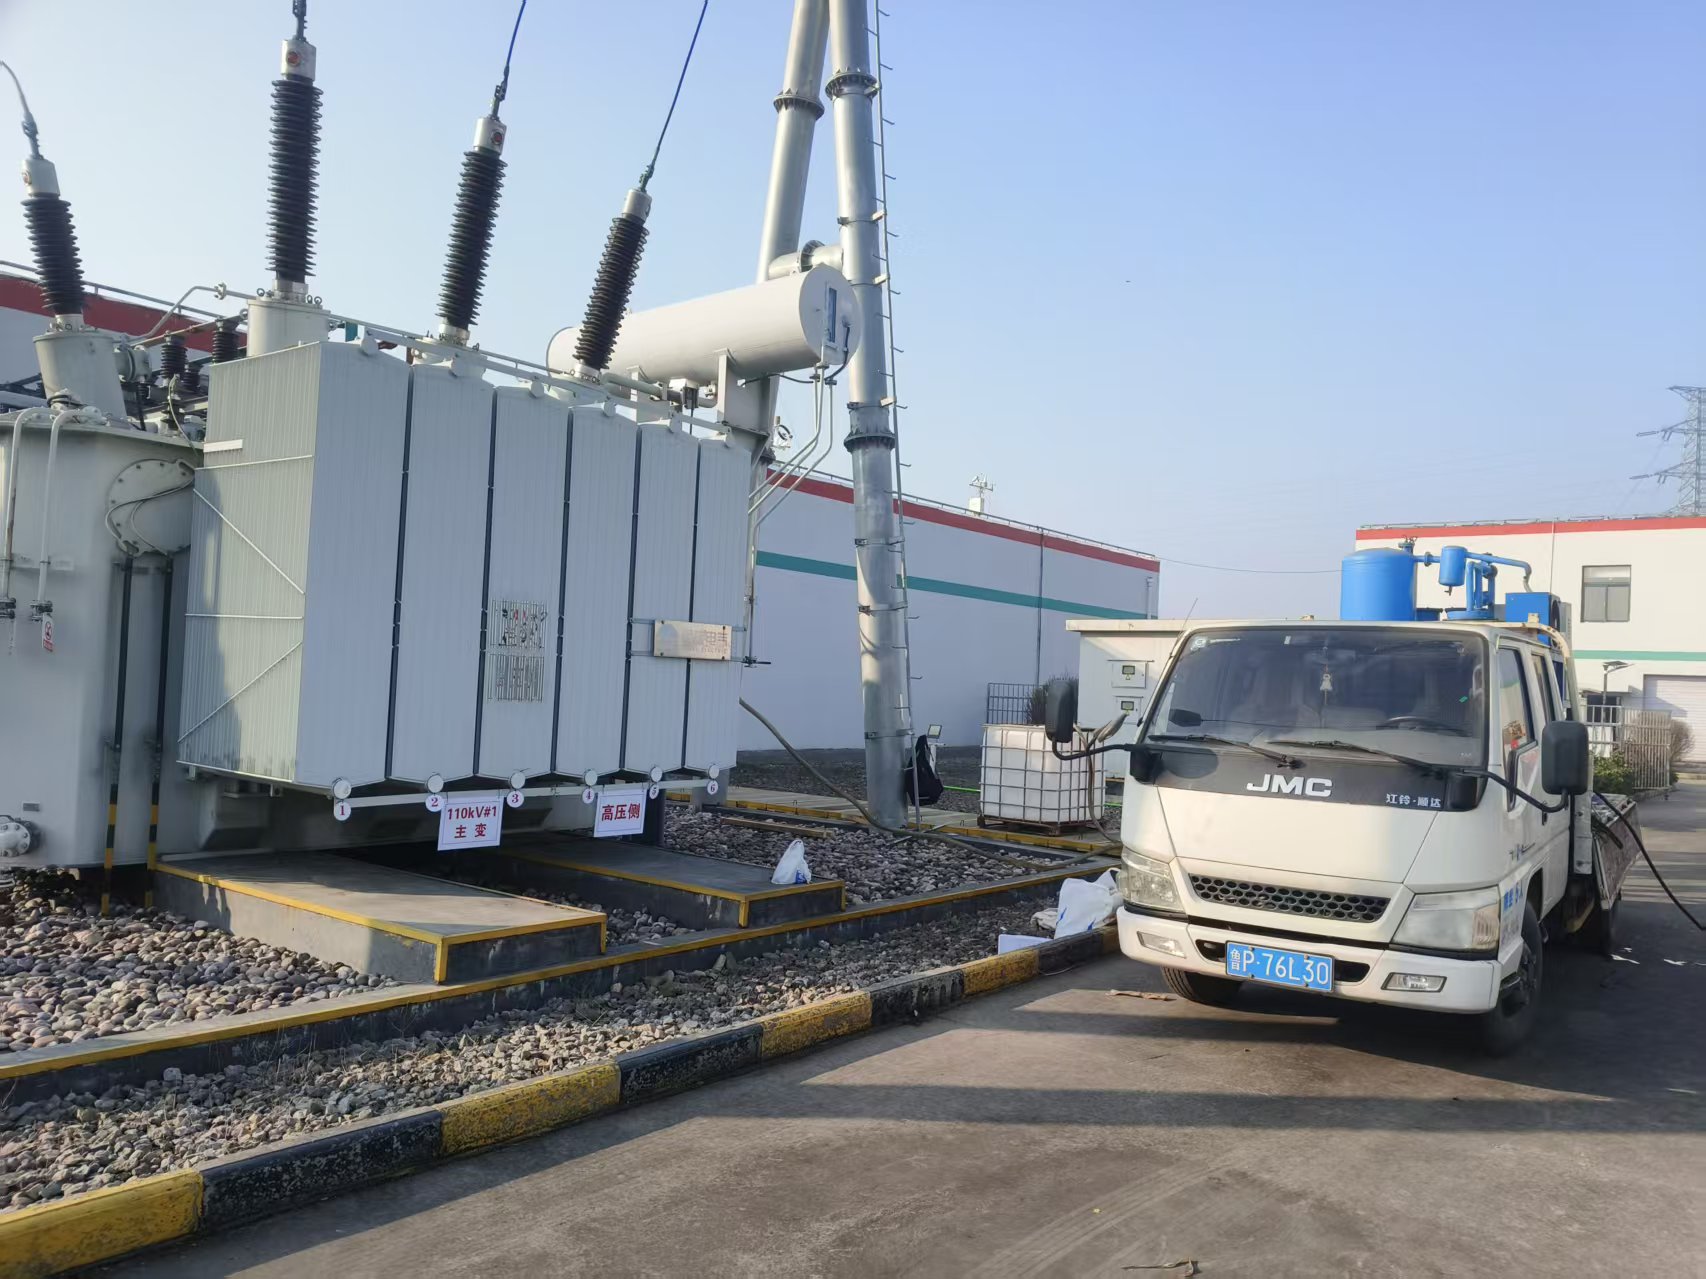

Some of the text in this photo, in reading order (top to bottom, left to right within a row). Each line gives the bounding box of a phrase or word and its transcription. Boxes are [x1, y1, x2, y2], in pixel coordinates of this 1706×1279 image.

[1246, 774, 1333, 797] JMC
[431, 797, 439, 807] 2
[511, 793, 519, 803] 3
[339, 805, 346, 816] 1
[448, 805, 497, 820] 110kV#1
[601, 803, 640, 821] 高压侧
